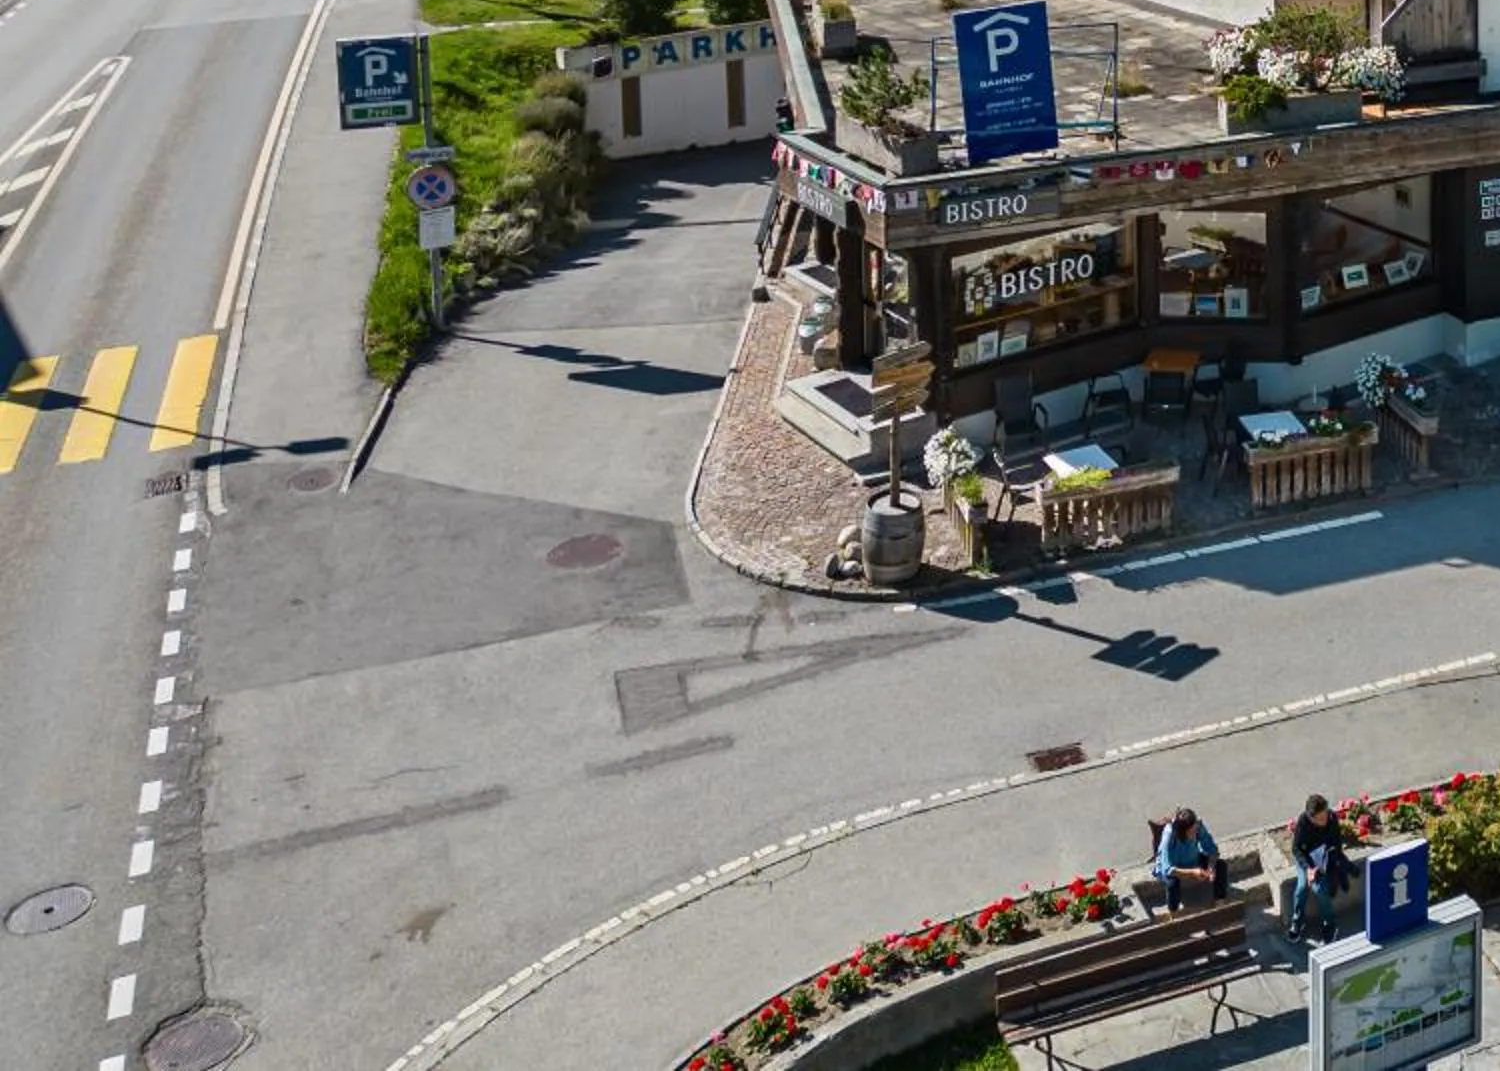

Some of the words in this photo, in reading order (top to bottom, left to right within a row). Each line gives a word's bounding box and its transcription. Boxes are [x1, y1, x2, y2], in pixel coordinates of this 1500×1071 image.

[986, 27, 1019, 73] P
[364, 54, 389, 87] P
[979, 72, 1034, 88] BAHNHOF
[945, 194, 1028, 224] BISTRO
[1000, 253, 1094, 299] BISTRO
